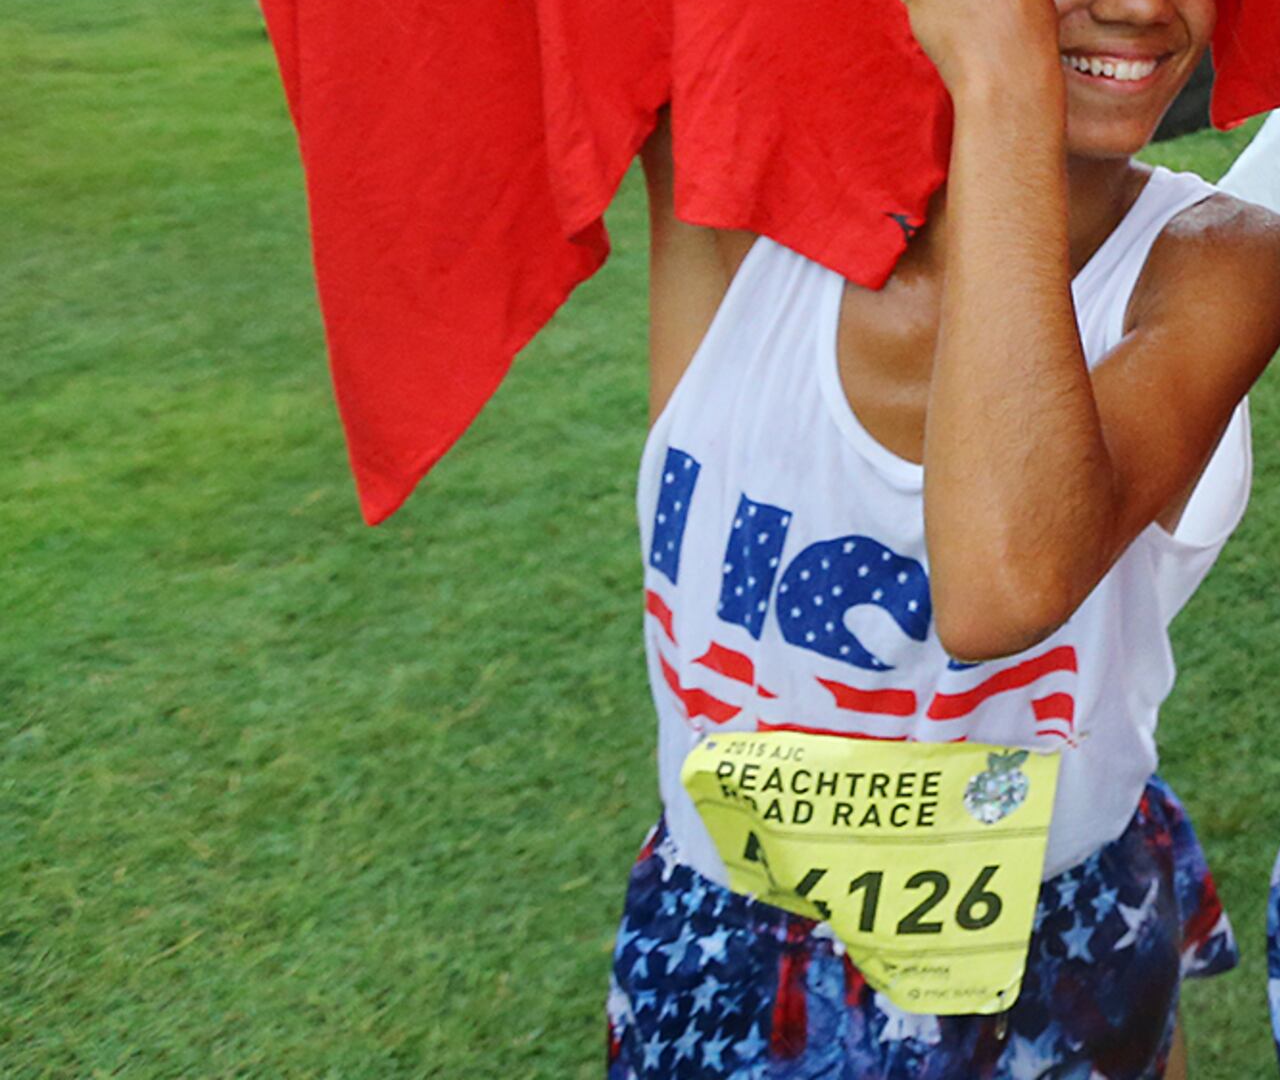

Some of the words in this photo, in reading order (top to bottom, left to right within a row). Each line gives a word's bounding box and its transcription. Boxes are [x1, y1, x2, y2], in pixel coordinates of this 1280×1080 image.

[723, 740, 767, 761] 2015
[770, 744, 806, 763] AJC
[715, 760, 943, 799] PEACHTREE
[831, 800, 938, 829] RACE
